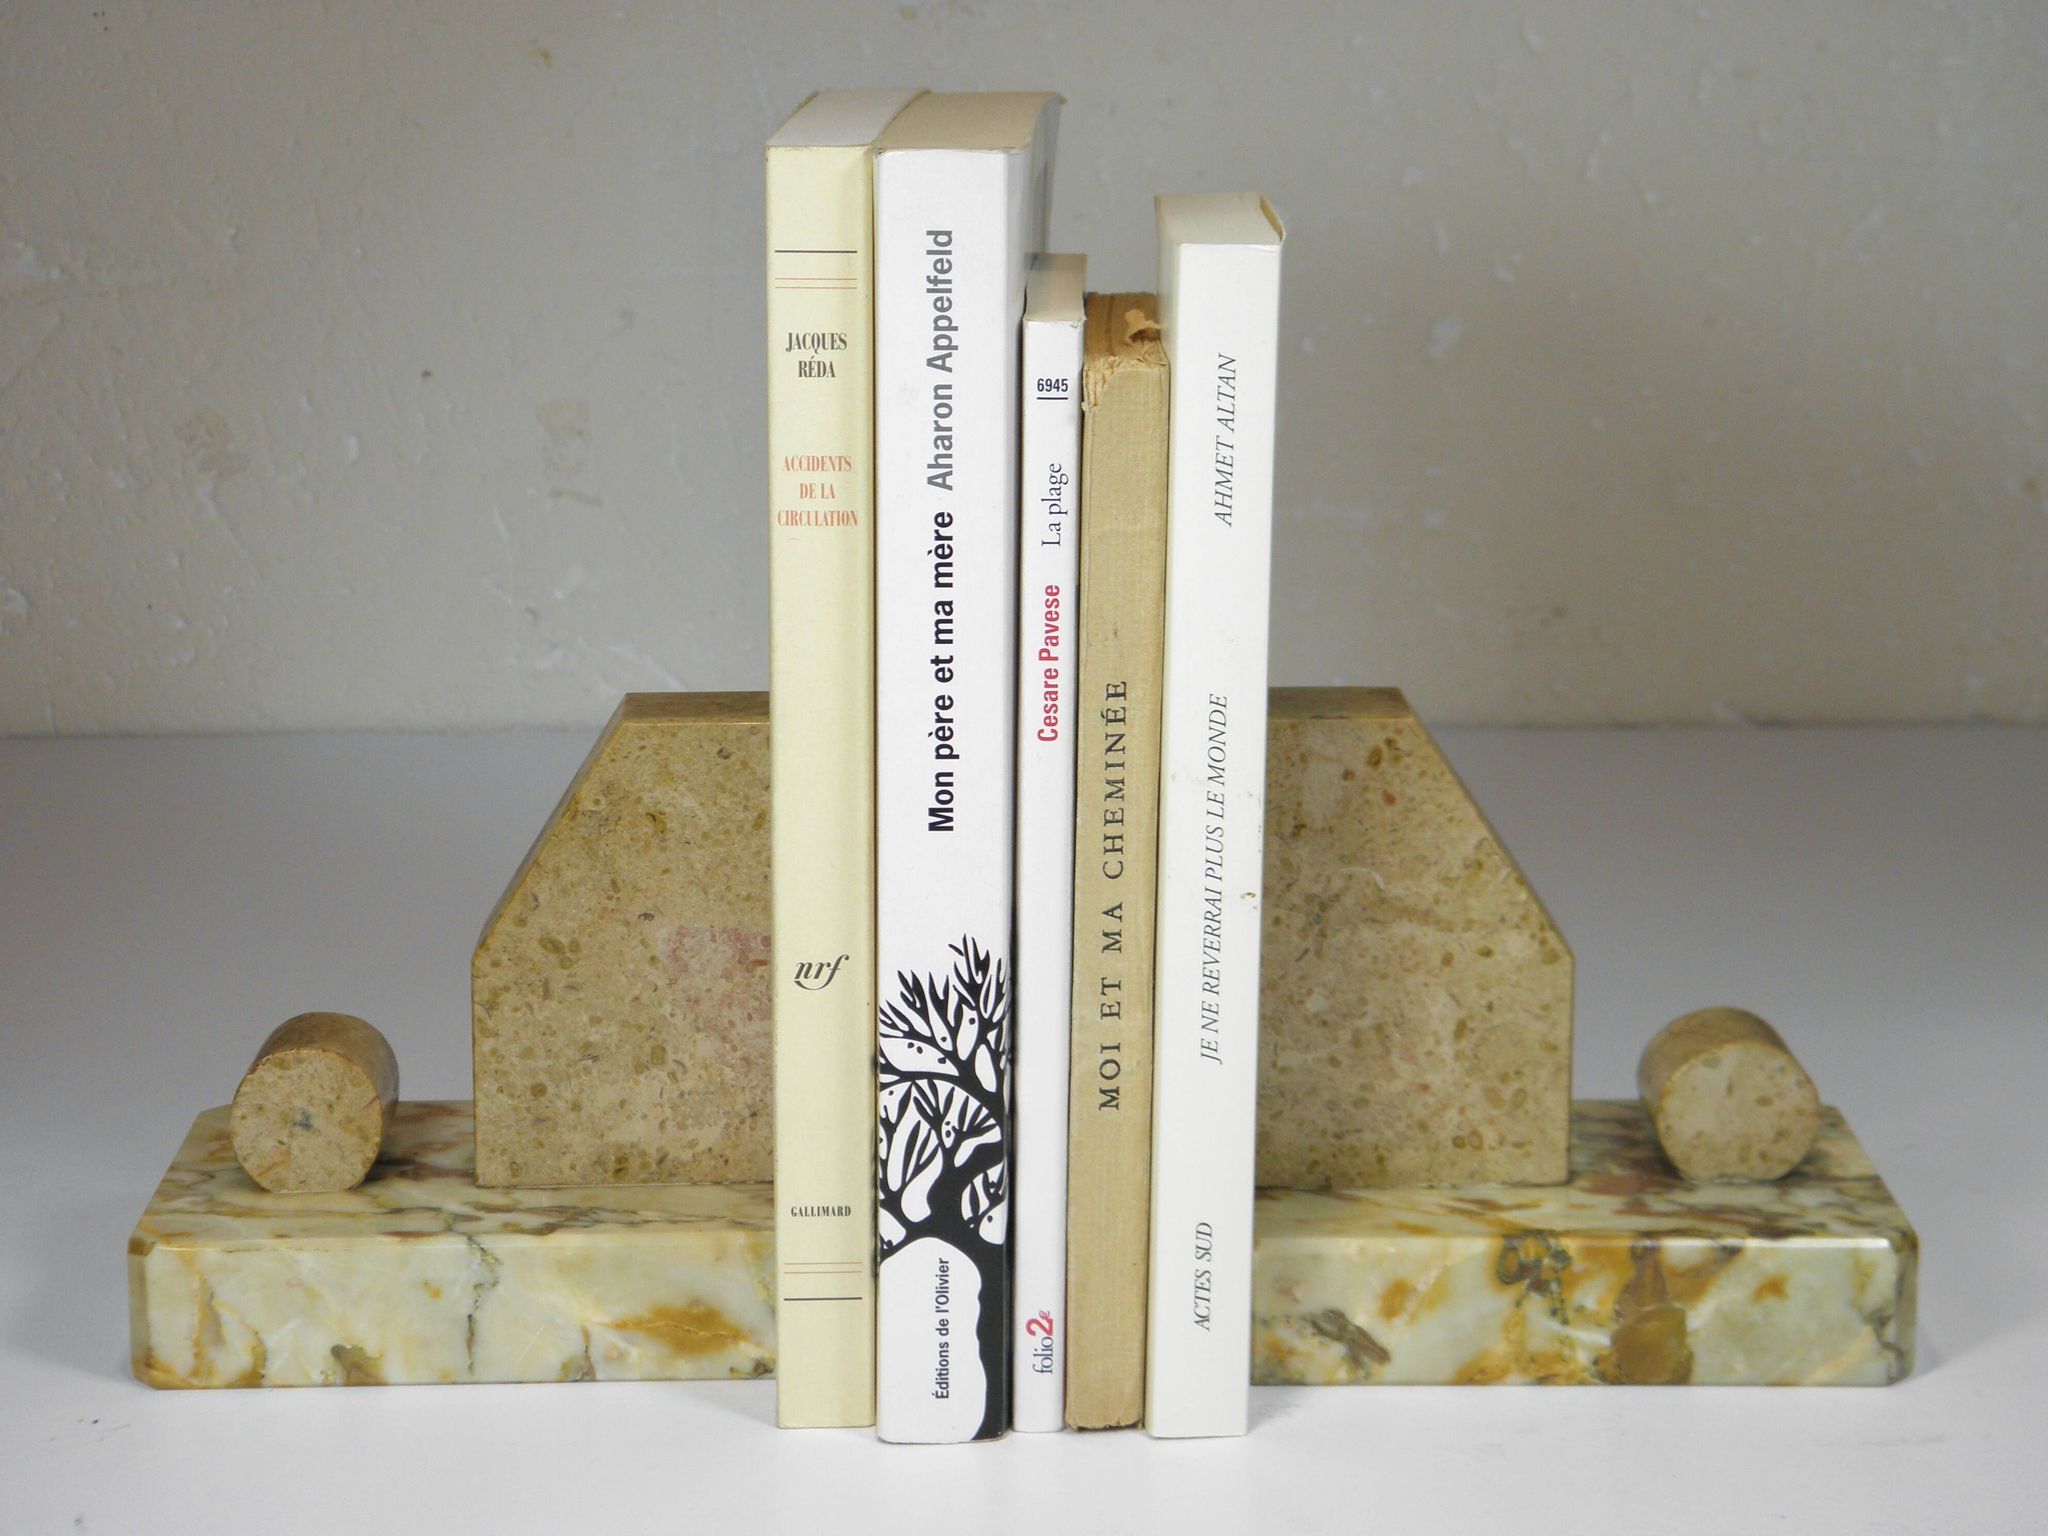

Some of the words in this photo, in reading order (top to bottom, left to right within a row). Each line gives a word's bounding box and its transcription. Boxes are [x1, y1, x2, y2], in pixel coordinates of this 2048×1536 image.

[925, 230, 959, 373] Appelfeld
[786, 332, 848, 354] JACQUES
[797, 356, 836, 379] RÉDA
[1036, 378, 1069, 393] 6945
[1216, 352, 1237, 433] ALTAN
[783, 455, 852, 472] ACCIDENTS
[926, 384, 953, 491] Aharon
[800, 482, 816, 499] DE
[821, 482, 836, 499] LA
[1041, 462, 1069, 516] plage
[1214, 434, 1235, 528] AHMET
[777, 510, 858, 527] CIRCULATION
[1041, 521, 1061, 547] La
[926, 511, 954, 589] mère
[934, 600, 954, 645] ma
[1037, 584, 1061, 662] Pavese
[929, 655, 954, 684] et
[927, 694, 961, 761] père
[1037, 668, 1060, 742] Cesare
[1206, 693, 1228, 787] MONDE
[927, 771, 954, 832] Mon
[1100, 680, 1128, 880] CHEMINÉE
[1207, 790, 1225, 820] LE
[1205, 824, 1225, 882] PLUS
[1101, 901, 1123, 954] MA
[1202, 886, 1223, 997] REVERRAI
[793, 953, 850, 991] nrf
[1100, 976, 1122, 1020] ET
[1201, 1000, 1220, 1035] NE
[1098, 1043, 1121, 1111] MOI
[1200, 1038, 1222, 1066] JE
[790, 1205, 852, 1218] GALLIMARD
[1195, 1221, 1213, 1263] SUD
[934, 1257, 950, 1314] l'Olivier
[1193, 1268, 1212, 1332] ACTES
[934, 1318, 950, 1337] de
[931, 1341, 950, 1400] Éditions
